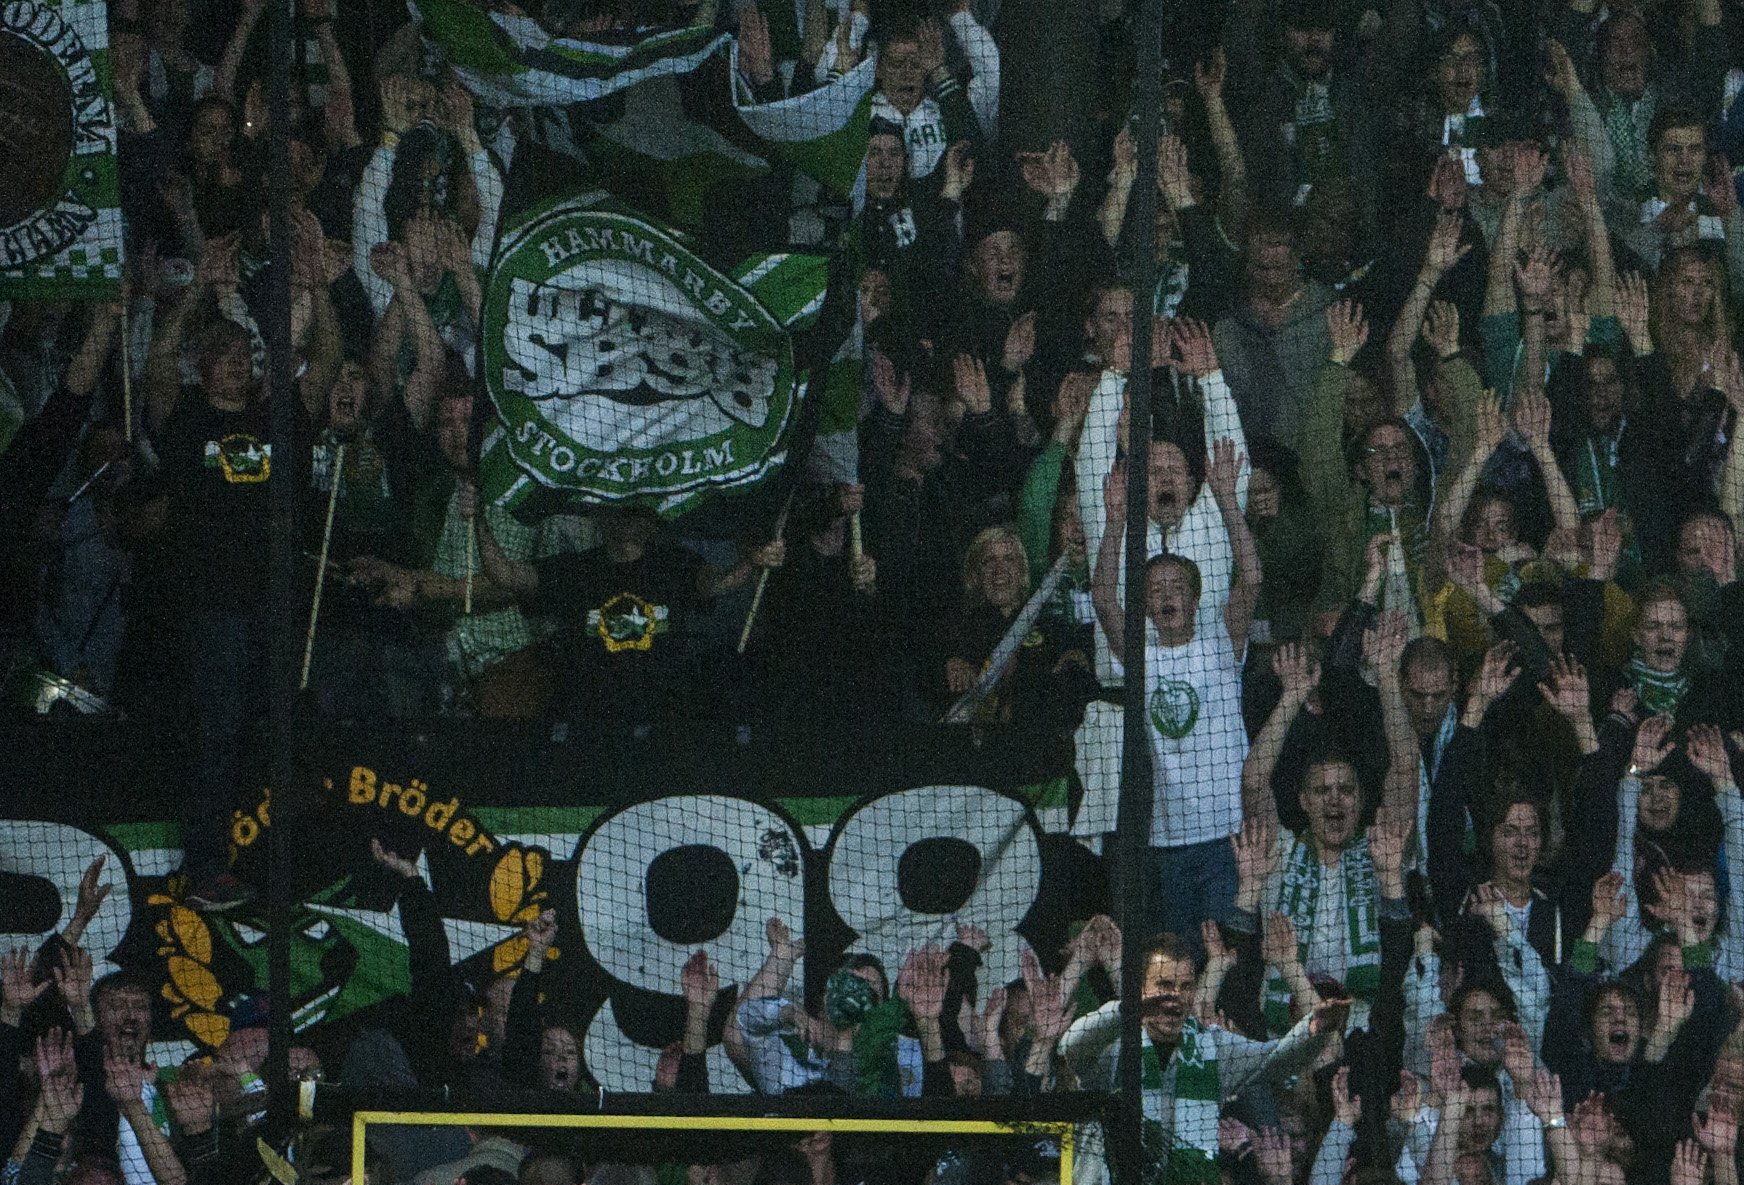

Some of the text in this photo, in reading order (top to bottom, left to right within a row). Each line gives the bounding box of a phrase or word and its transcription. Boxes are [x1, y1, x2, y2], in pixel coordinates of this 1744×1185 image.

[540, 227, 756, 332] HAMMARBY
[515, 420, 735, 483] STOCKHOLM
[350, 765, 494, 857] Bröder
